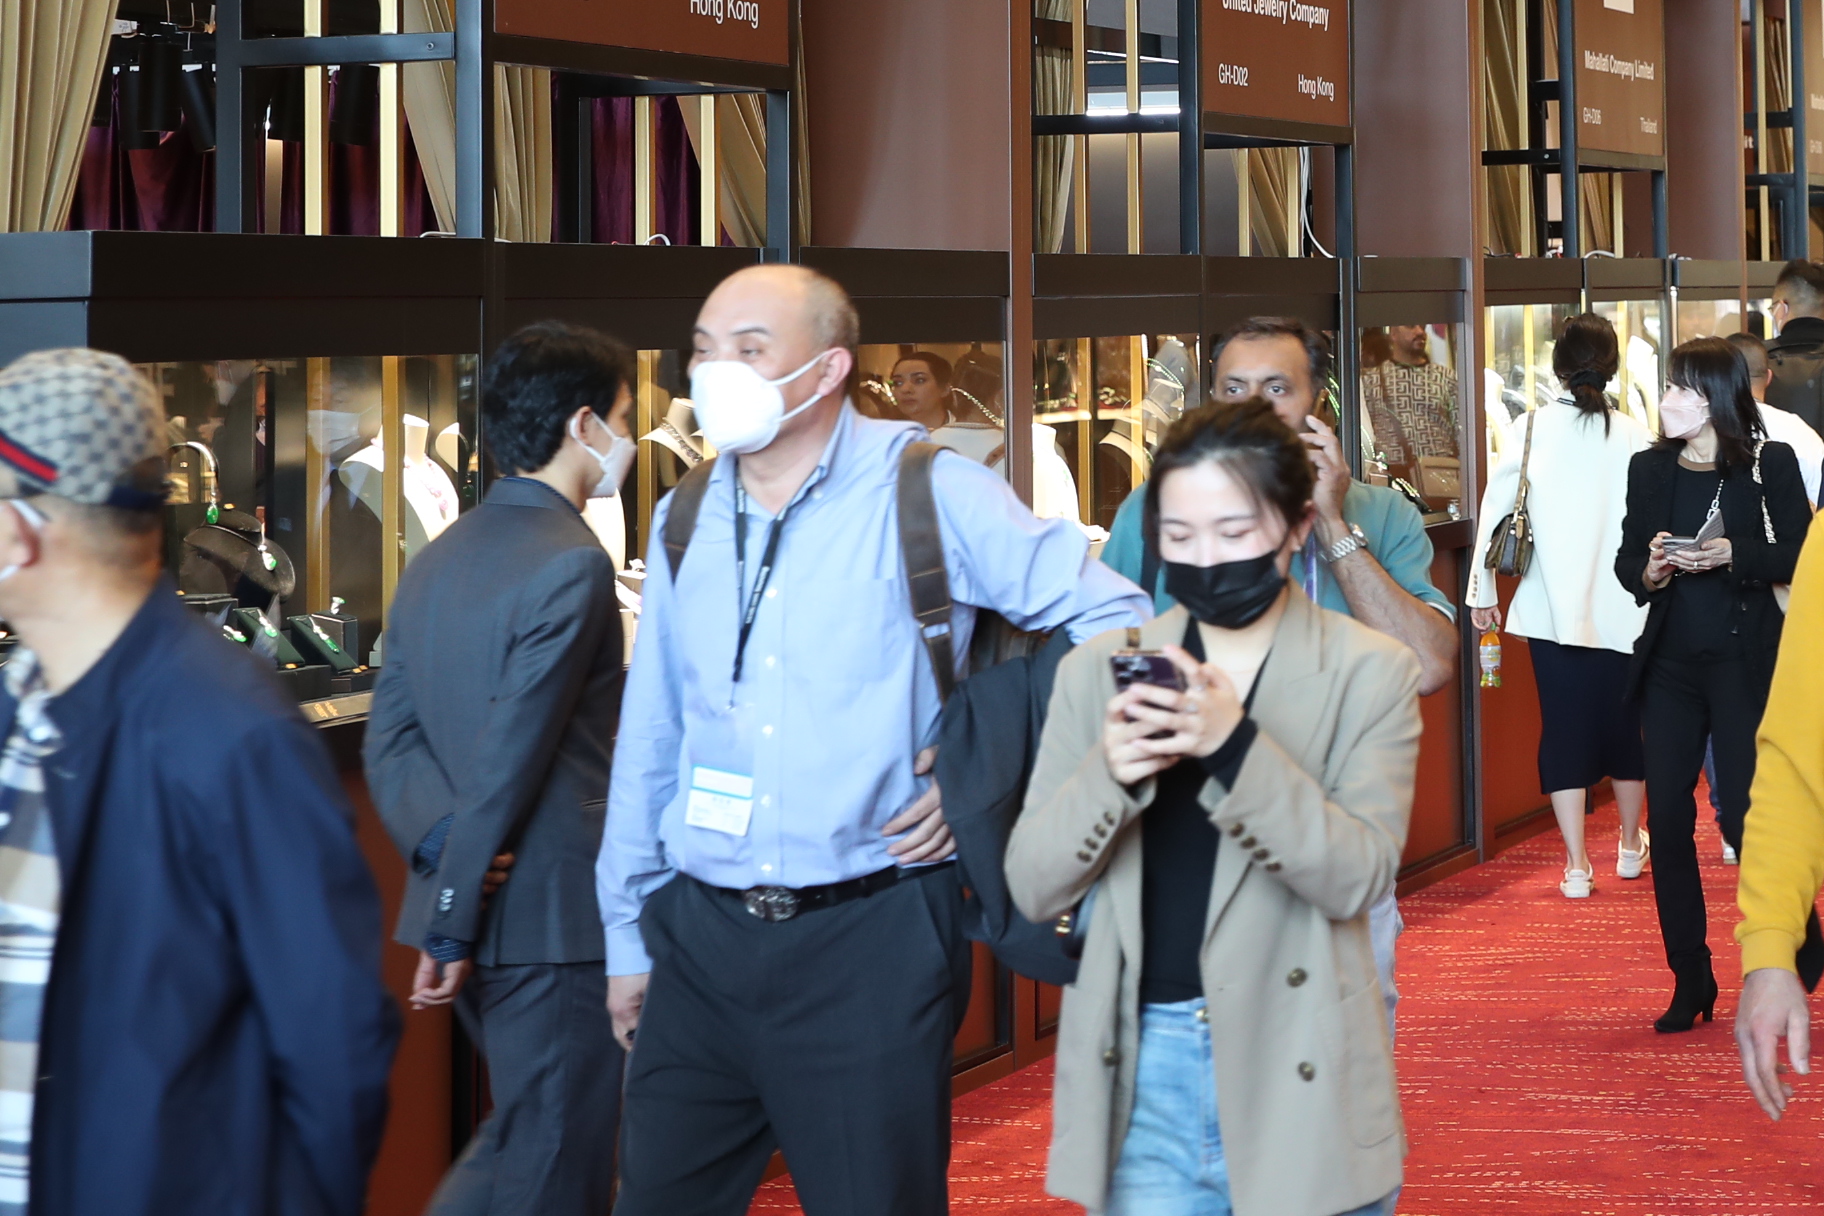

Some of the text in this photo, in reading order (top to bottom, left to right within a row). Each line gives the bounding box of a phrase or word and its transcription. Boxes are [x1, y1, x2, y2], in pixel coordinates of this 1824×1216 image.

[1218, 63, 1249, 87] GH-D02
[1609, 54, 1634, 81] Company
[1634, 59, 1654, 81] Limited
[1298, 73, 1334, 102] Hong Kong
